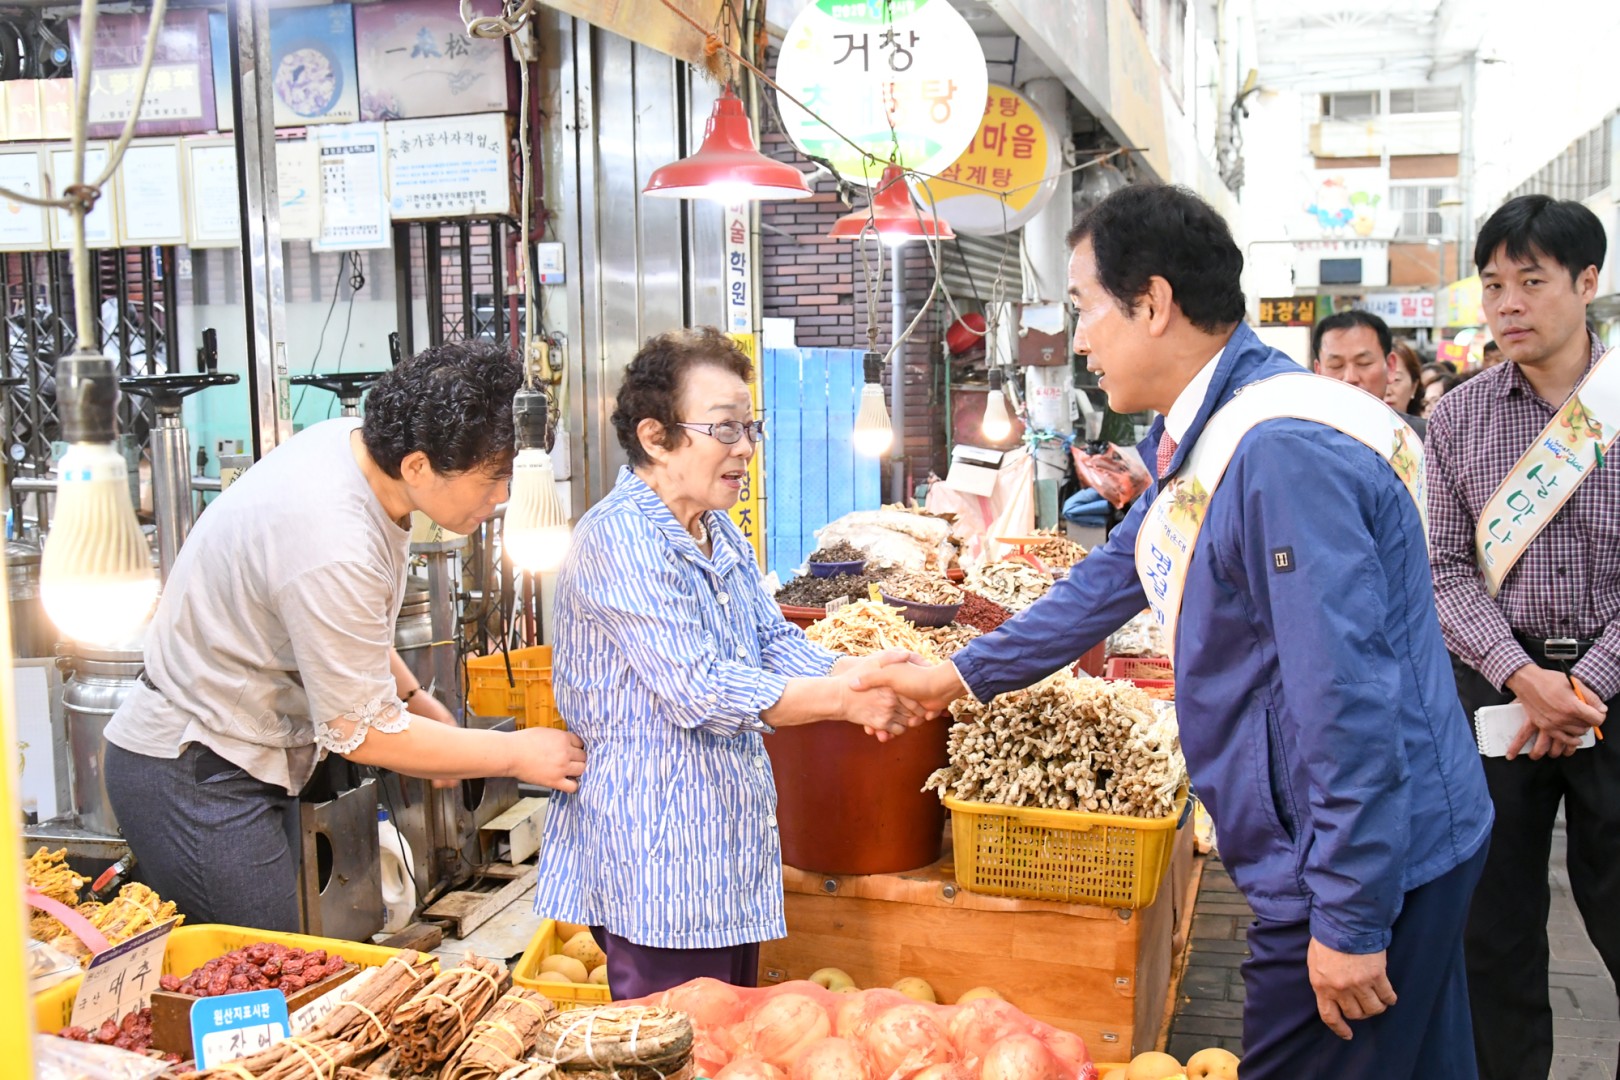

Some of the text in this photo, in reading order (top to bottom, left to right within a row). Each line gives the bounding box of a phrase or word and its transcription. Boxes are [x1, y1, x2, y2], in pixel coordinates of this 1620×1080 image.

[833, 30, 920, 72] 거창
[968, 121, 1037, 160] 마을
[213, 1003, 270, 1026] 원산지표시판
